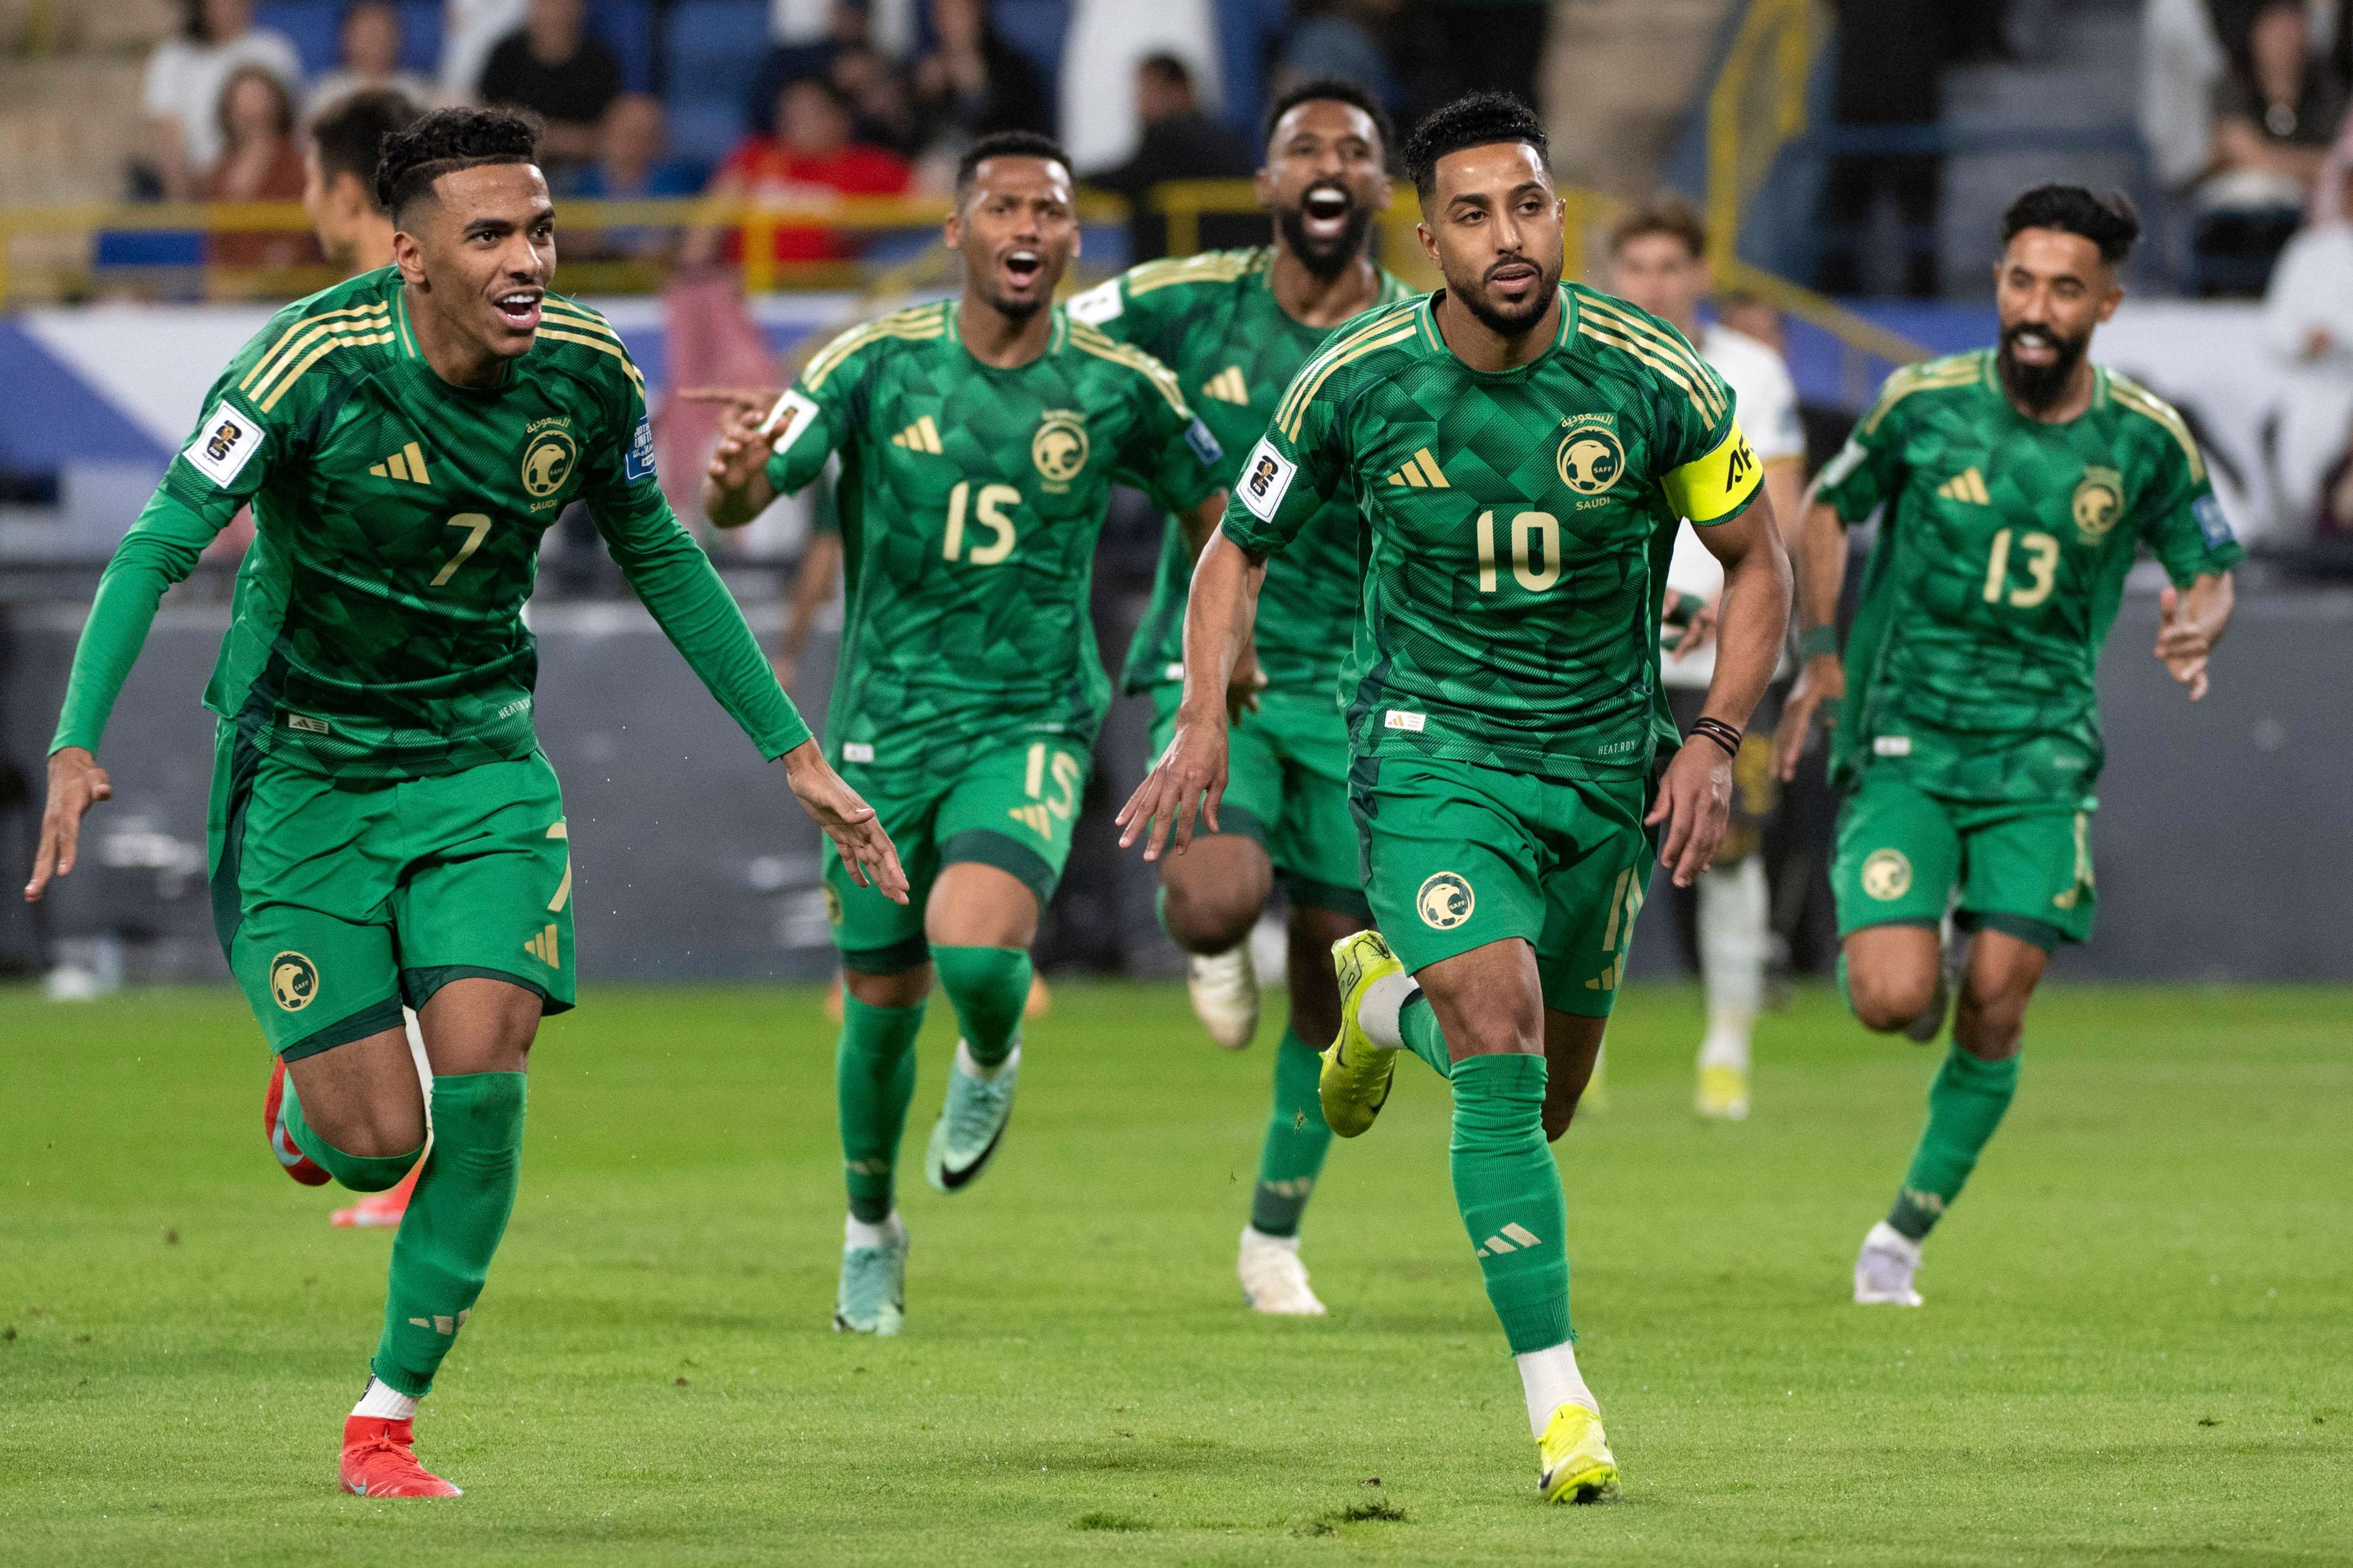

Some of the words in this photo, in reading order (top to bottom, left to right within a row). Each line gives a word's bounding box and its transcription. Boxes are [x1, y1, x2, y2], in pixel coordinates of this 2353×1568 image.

[526, 417, 570, 433] السعودية
[1560, 413, 1614, 428] السعودية
[550, 467, 564, 476] SAFF
[1726, 434, 1755, 493] AF
[529, 499, 558, 513] SAUDI
[1576, 497, 1610, 510] SAUDI
[943, 481, 1022, 565] 15
[430, 513, 491, 585] 7
[1477, 510, 1561, 592] 10
[1983, 529, 2060, 608] 13
[1598, 740, 1635, 756] HEAT.RDY
[1025, 742, 1079, 820] 15
[1449, 900, 1465, 910] SAFF
[294, 980, 309, 991] SAFF
